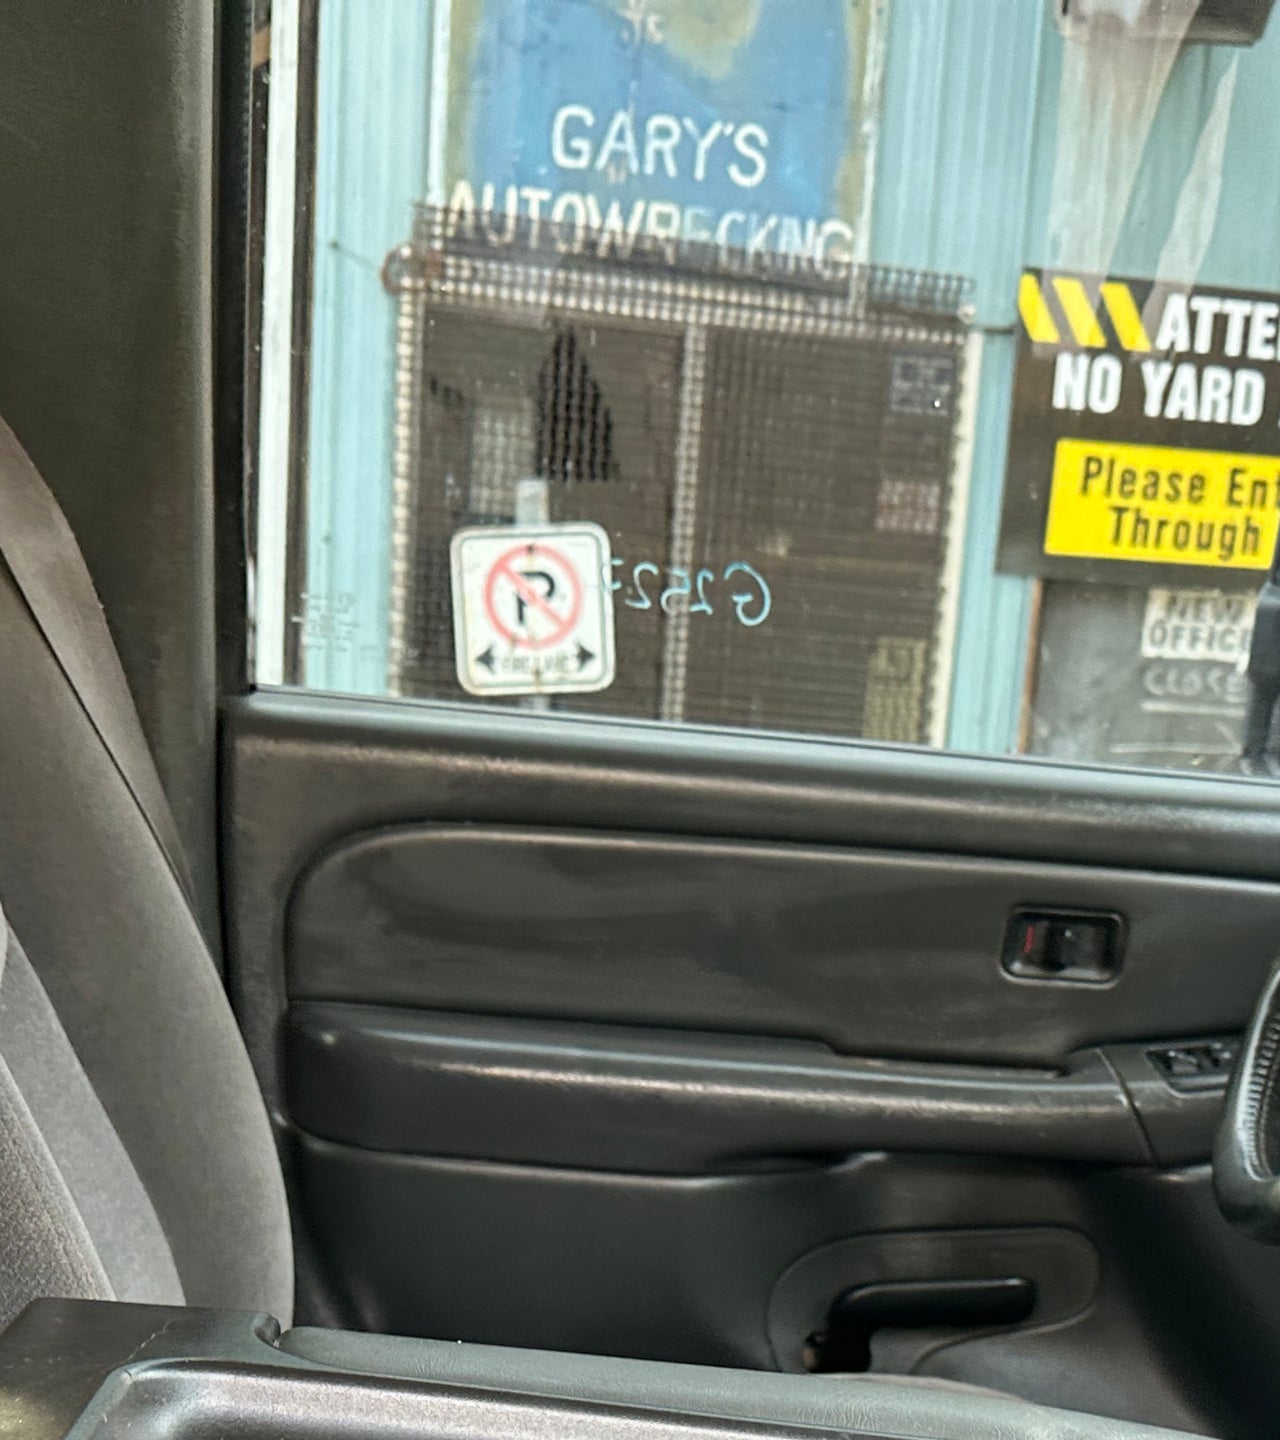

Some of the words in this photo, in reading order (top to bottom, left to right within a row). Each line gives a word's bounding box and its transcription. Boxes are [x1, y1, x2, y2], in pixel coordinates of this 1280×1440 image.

[551, 104, 769, 188] GARY'S
[1052, 352, 1122, 414] NO
[1141, 359, 1266, 426] YARD
[1081, 455, 1207, 503] Please
[1108, 505, 1262, 562] Through
